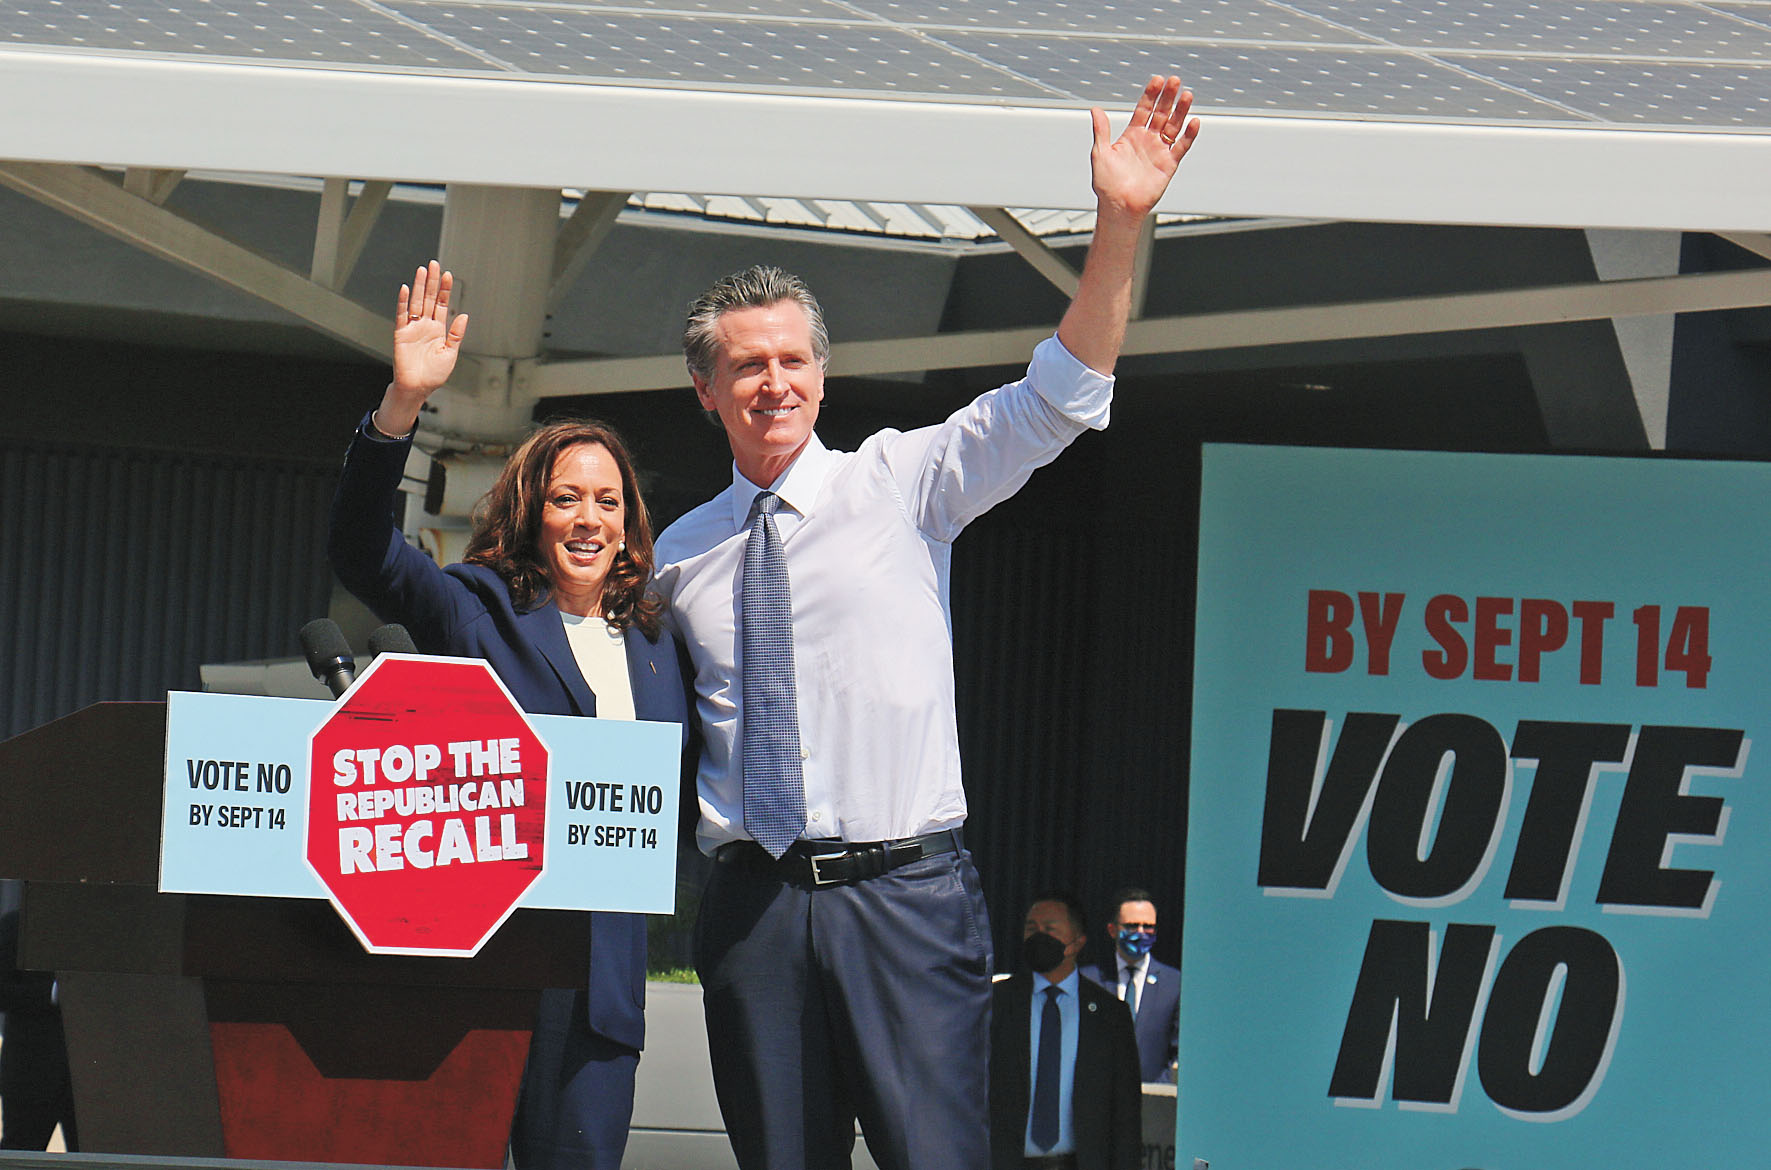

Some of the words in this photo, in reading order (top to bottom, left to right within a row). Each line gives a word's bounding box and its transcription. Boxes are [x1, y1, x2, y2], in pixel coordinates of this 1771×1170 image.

[1305, 588, 1406, 676] BY
[1421, 593, 1615, 686] SEPT
[1633, 604, 1713, 689] 14
[186, 759, 250, 792] VOTE
[256, 763, 292, 795] NO
[333, 743, 442, 787] STOP
[447, 737, 522, 778] THE
[189, 804, 214, 827] BY
[217, 805, 264, 829] SEPT
[267, 808, 286, 830] 14
[336, 778, 525, 822] REPUBLICAN
[565, 781, 624, 813] VOTE
[630, 784, 663, 815] NO
[1257, 707, 1752, 919] VOTE
[338, 813, 529, 875] RECALL
[567, 824, 591, 846] BY
[593, 825, 637, 848] SEPT
[640, 828, 657, 850] 14
[1328, 918, 1627, 1123] NO
